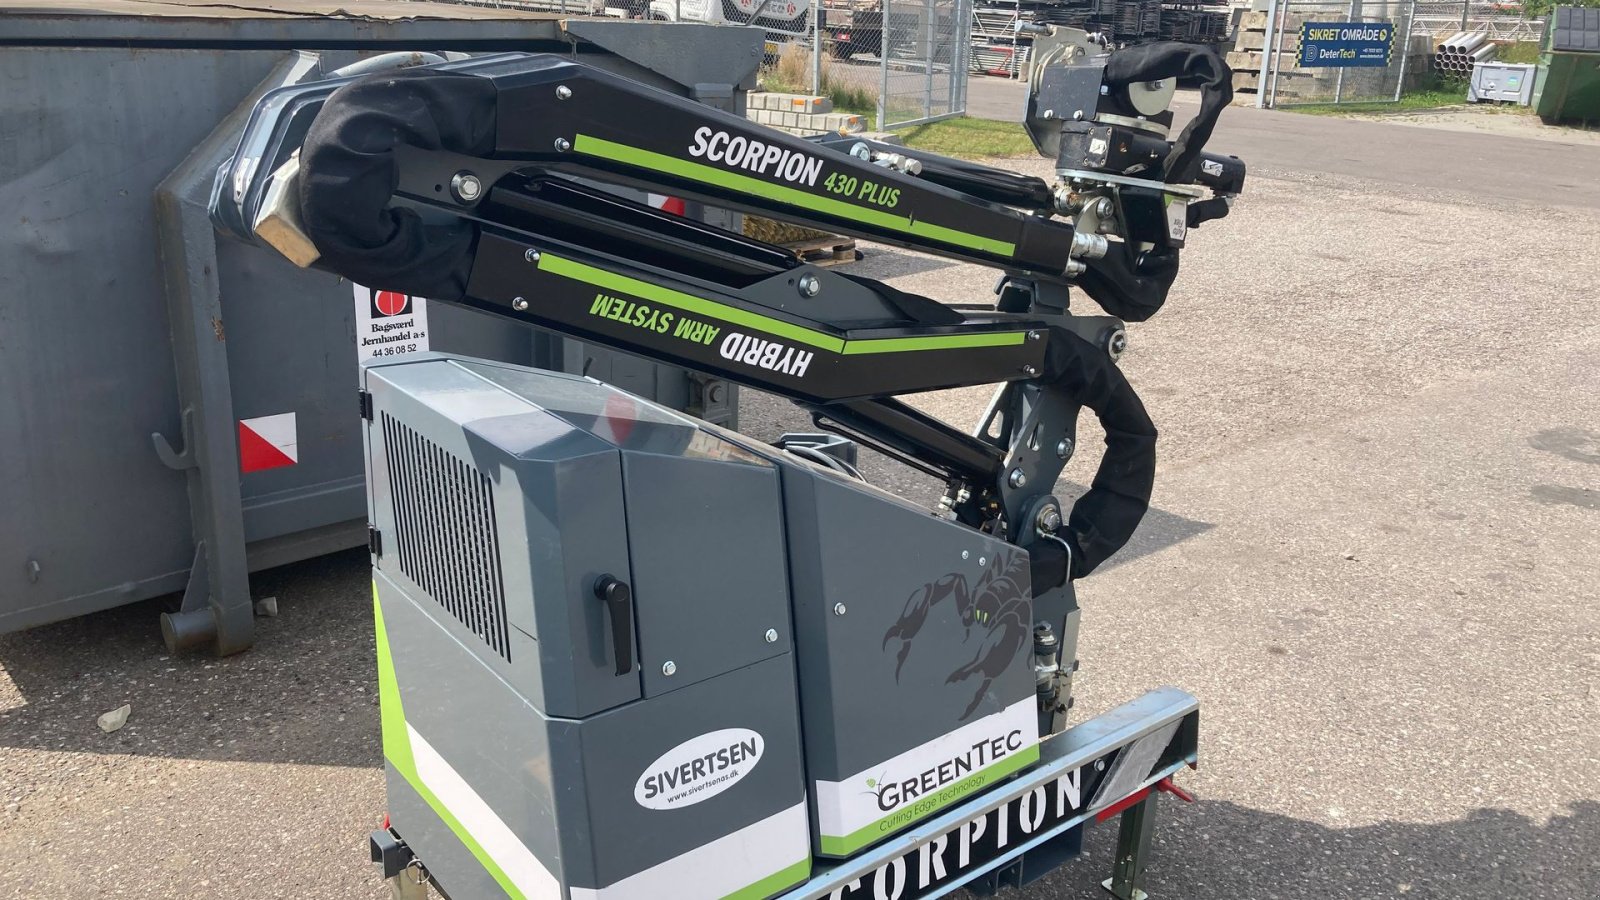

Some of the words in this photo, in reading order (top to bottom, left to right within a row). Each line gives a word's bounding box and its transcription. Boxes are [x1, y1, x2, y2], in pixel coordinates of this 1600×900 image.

[1308, 28, 1340, 41] SIKRET
[1341, 25, 1379, 41] OMRÅDE
[1319, 48, 1355, 59] DeterTech
[688, 126, 823, 187] SCORPION
[823, 172, 857, 197] 430
[857, 180, 900, 209] PLUS
[371, 318, 414, 333] Bagsværd
[589, 294, 674, 333] SYSTEM
[361, 331, 411, 347] Jernhandel
[673, 317, 721, 346] ARM
[384, 347, 395, 356] 36
[395, 345, 406, 355] 08
[407, 343, 417, 352] 52
[719, 332, 814, 378] HYBRID
[644, 737, 757, 799] SIVERTSEN
[667, 769, 739, 803] www.sivertsenas.dk
[879, 812, 913, 831] Cutting
[914, 797, 937, 817] Edge
[938, 774, 986, 804] Technology
